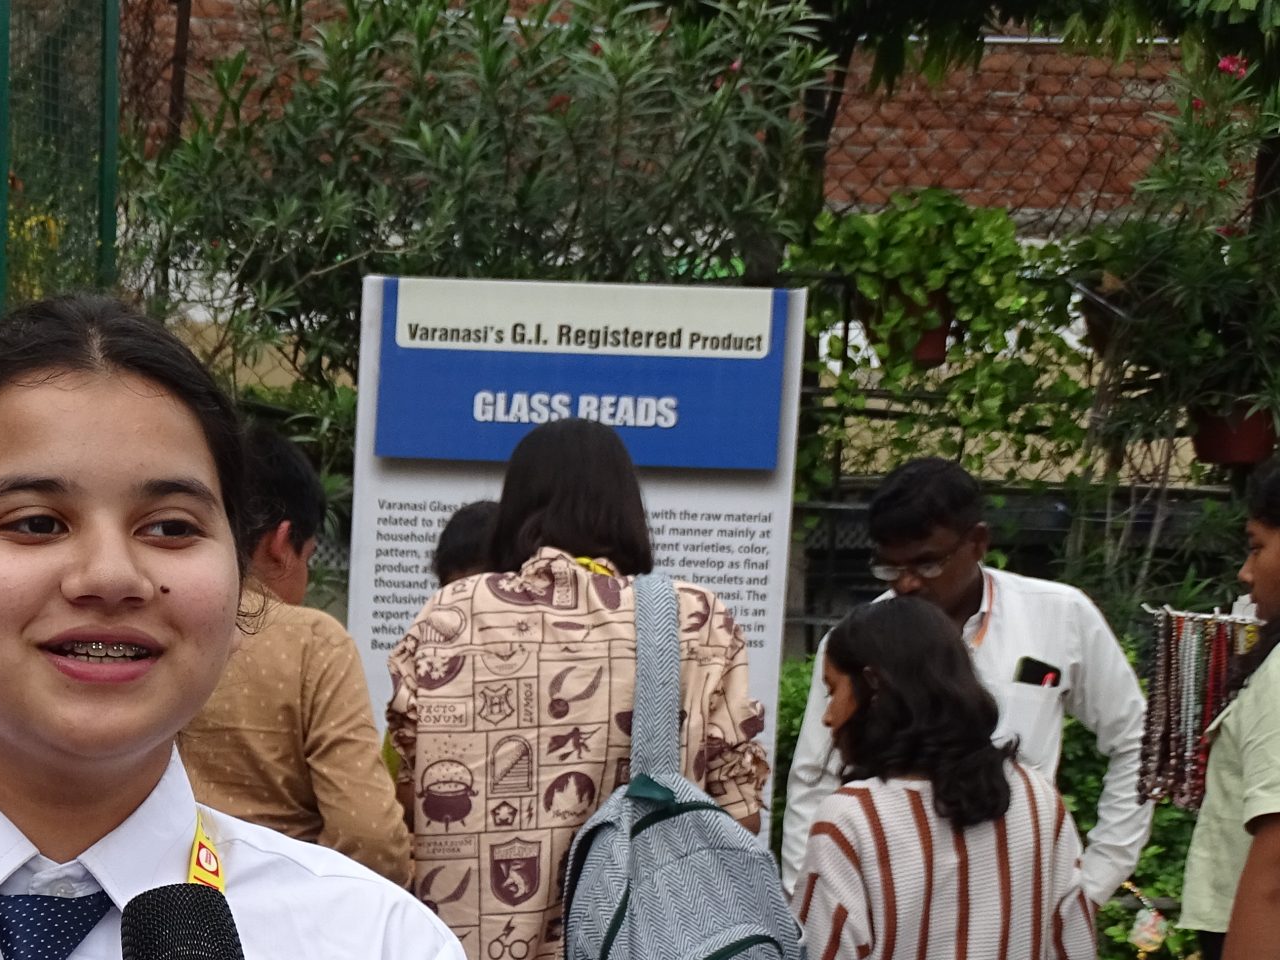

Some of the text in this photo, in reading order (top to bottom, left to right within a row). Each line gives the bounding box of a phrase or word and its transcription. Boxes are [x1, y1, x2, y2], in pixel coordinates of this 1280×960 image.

[408, 322, 763, 351] Varanasi's G.I. Registered Product
[473, 390, 571, 424] GLASS
[378, 499, 426, 512] Varanasi
[377, 515, 433, 527] related to
[651, 509, 772, 523] with the raw material
[376, 531, 436, 543] household
[668, 527, 713, 537] manner
[716, 528, 756, 541] mainly
[759, 530, 771, 539] at
[374, 562, 420, 575] product
[678, 556, 769, 571] develop as final
[374, 578, 428, 590] thousand
[692, 573, 744, 585] bracelets
[745, 574, 768, 586] and
[746, 590, 767, 602] The
[371, 624, 405, 635] which
